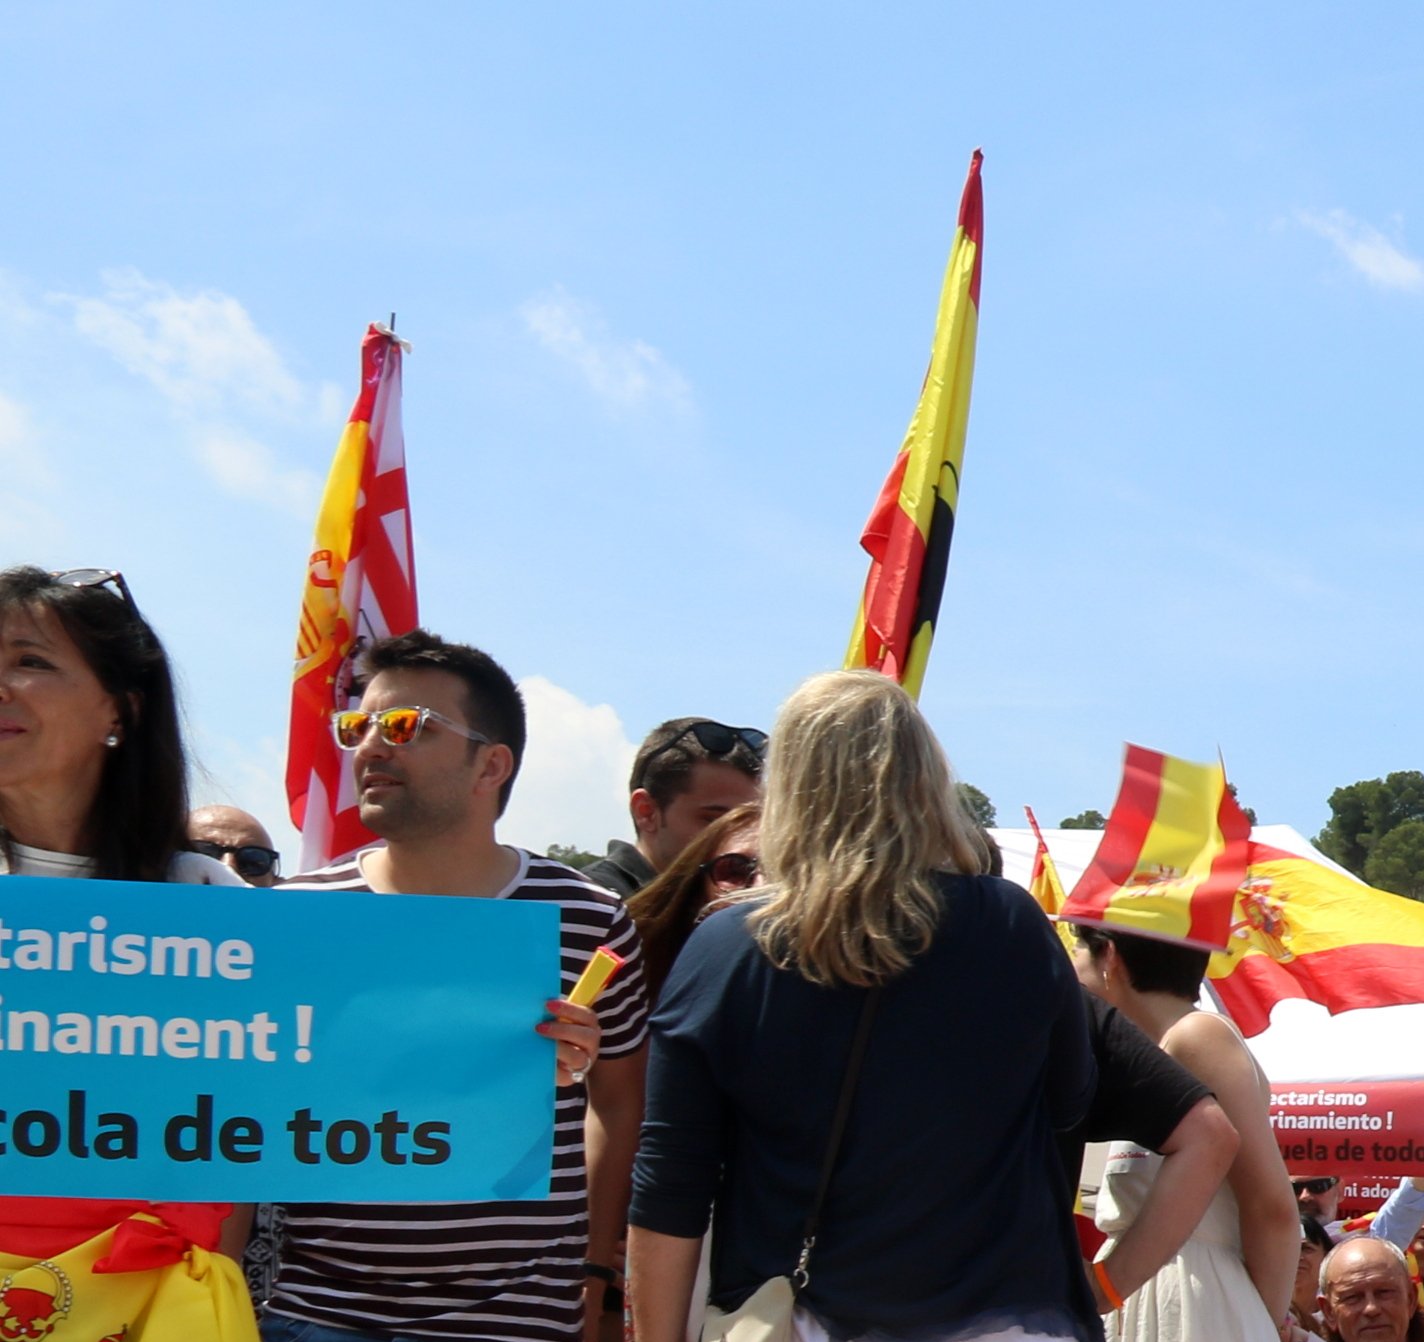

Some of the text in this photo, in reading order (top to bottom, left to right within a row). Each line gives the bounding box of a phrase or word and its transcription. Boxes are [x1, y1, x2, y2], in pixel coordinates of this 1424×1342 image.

[295, 1004, 314, 1063] !
[163, 1093, 265, 1164] de
[286, 1106, 452, 1167] tots
[1386, 1111, 1394, 1131] !
[1335, 1138, 1365, 1161] de
